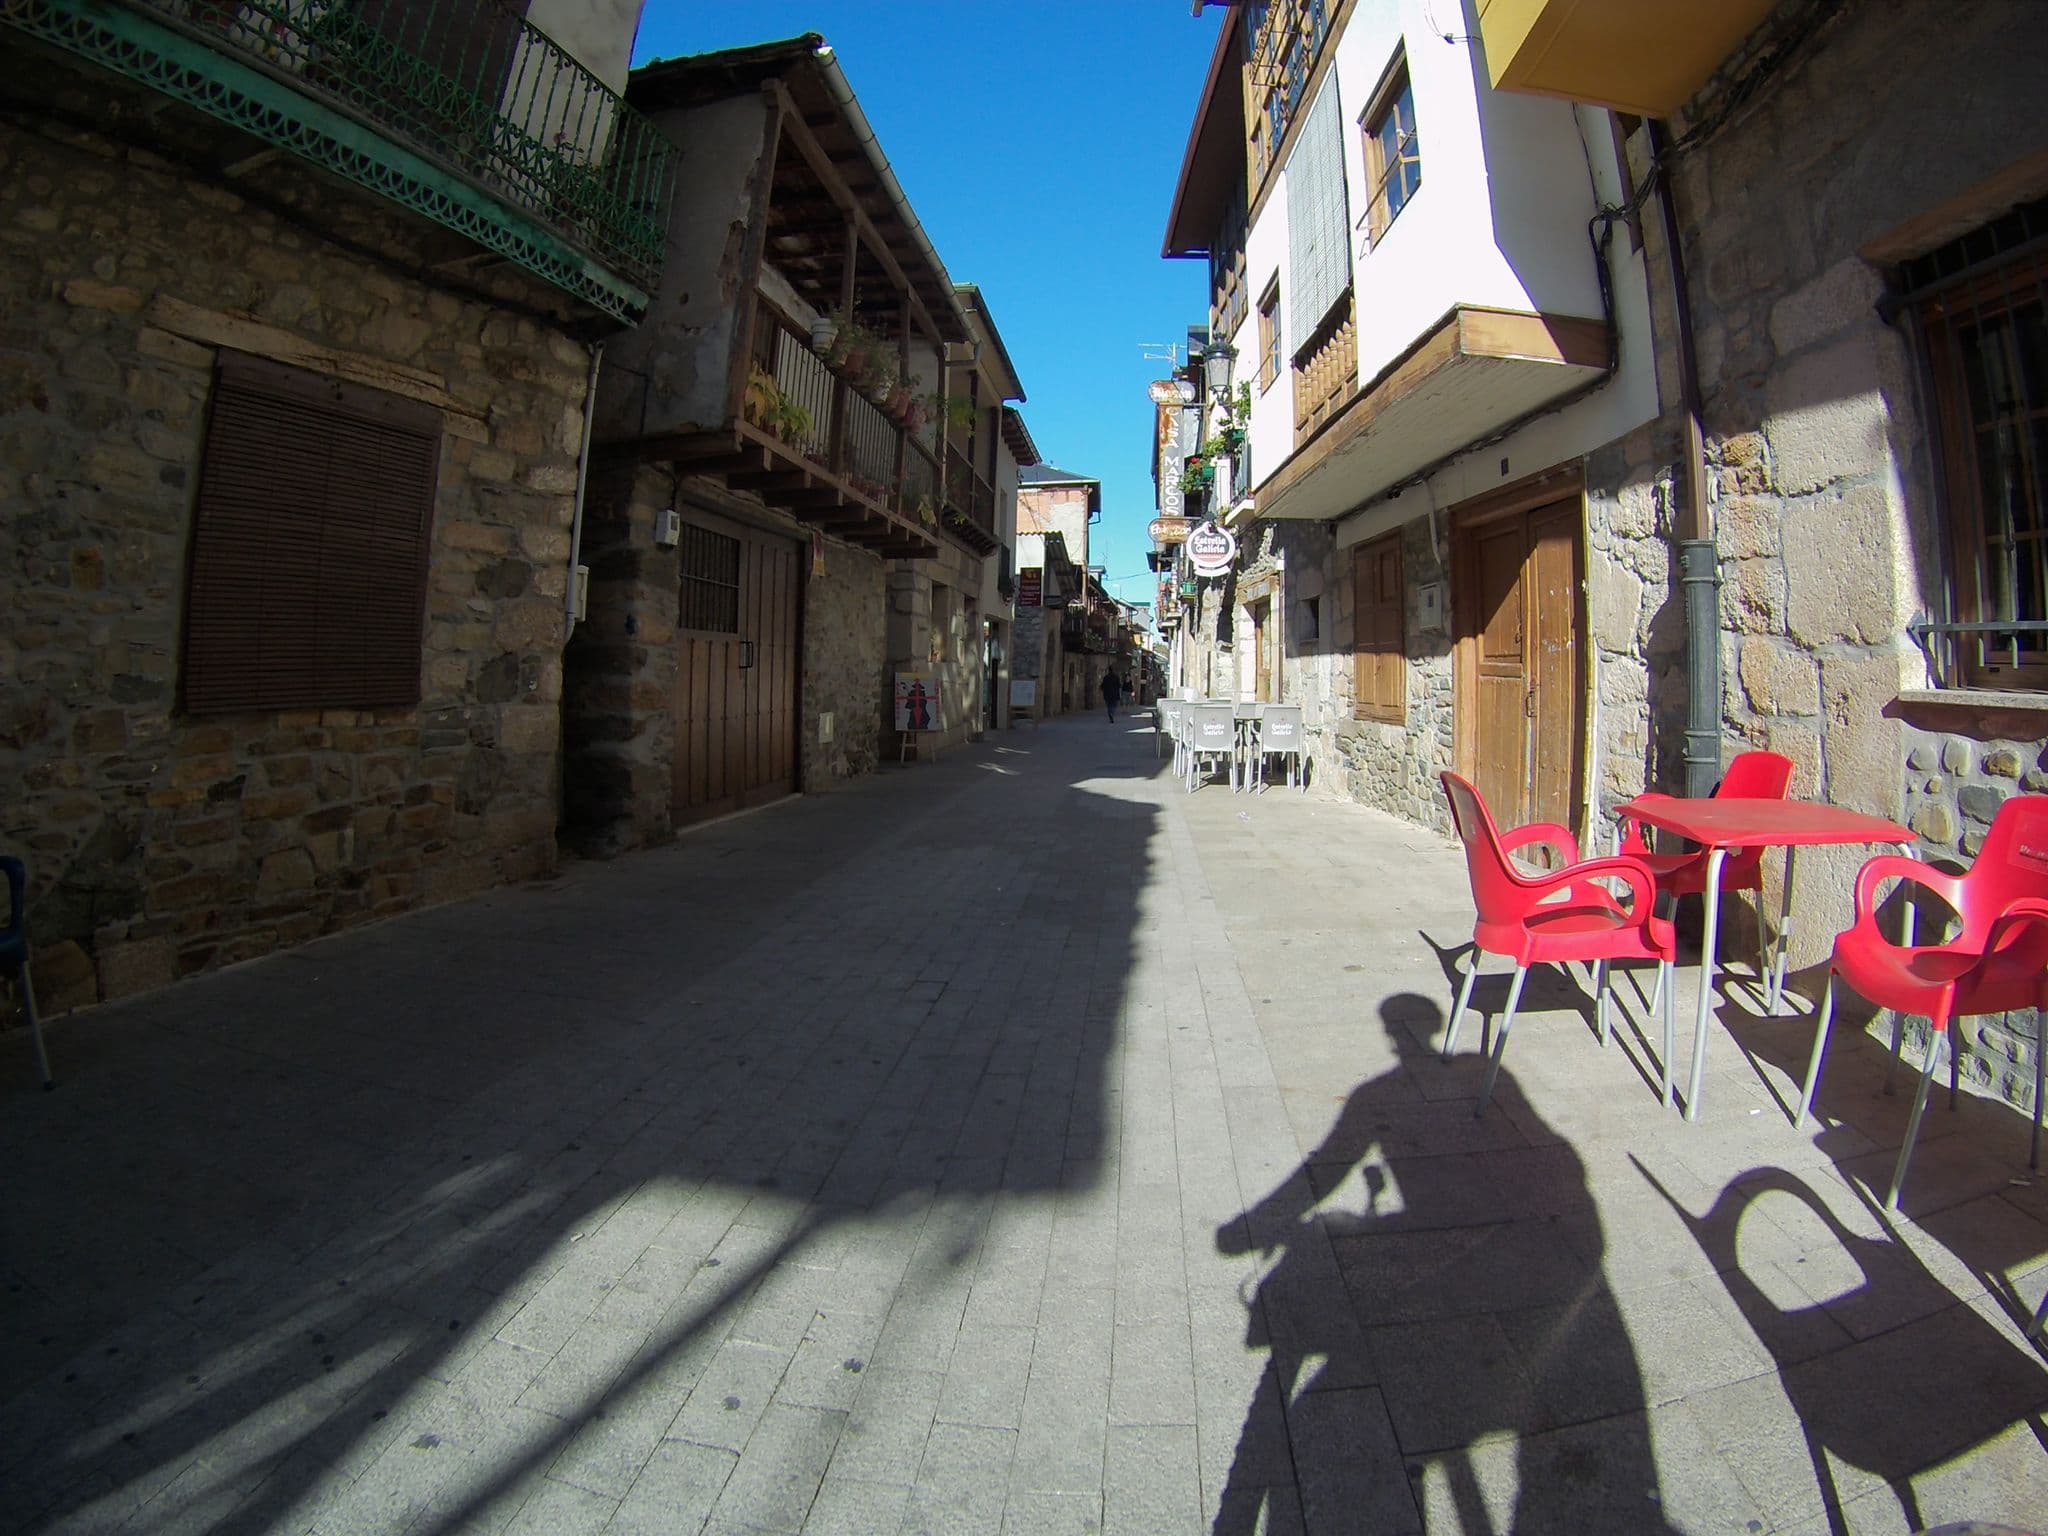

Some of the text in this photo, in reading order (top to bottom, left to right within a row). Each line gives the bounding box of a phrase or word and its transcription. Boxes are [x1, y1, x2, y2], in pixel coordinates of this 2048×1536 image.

[1164, 407, 1180, 516] CASA MARCOS
[1194, 536, 1227, 544] Estrella
[1195, 544, 1226, 553] Galicia
